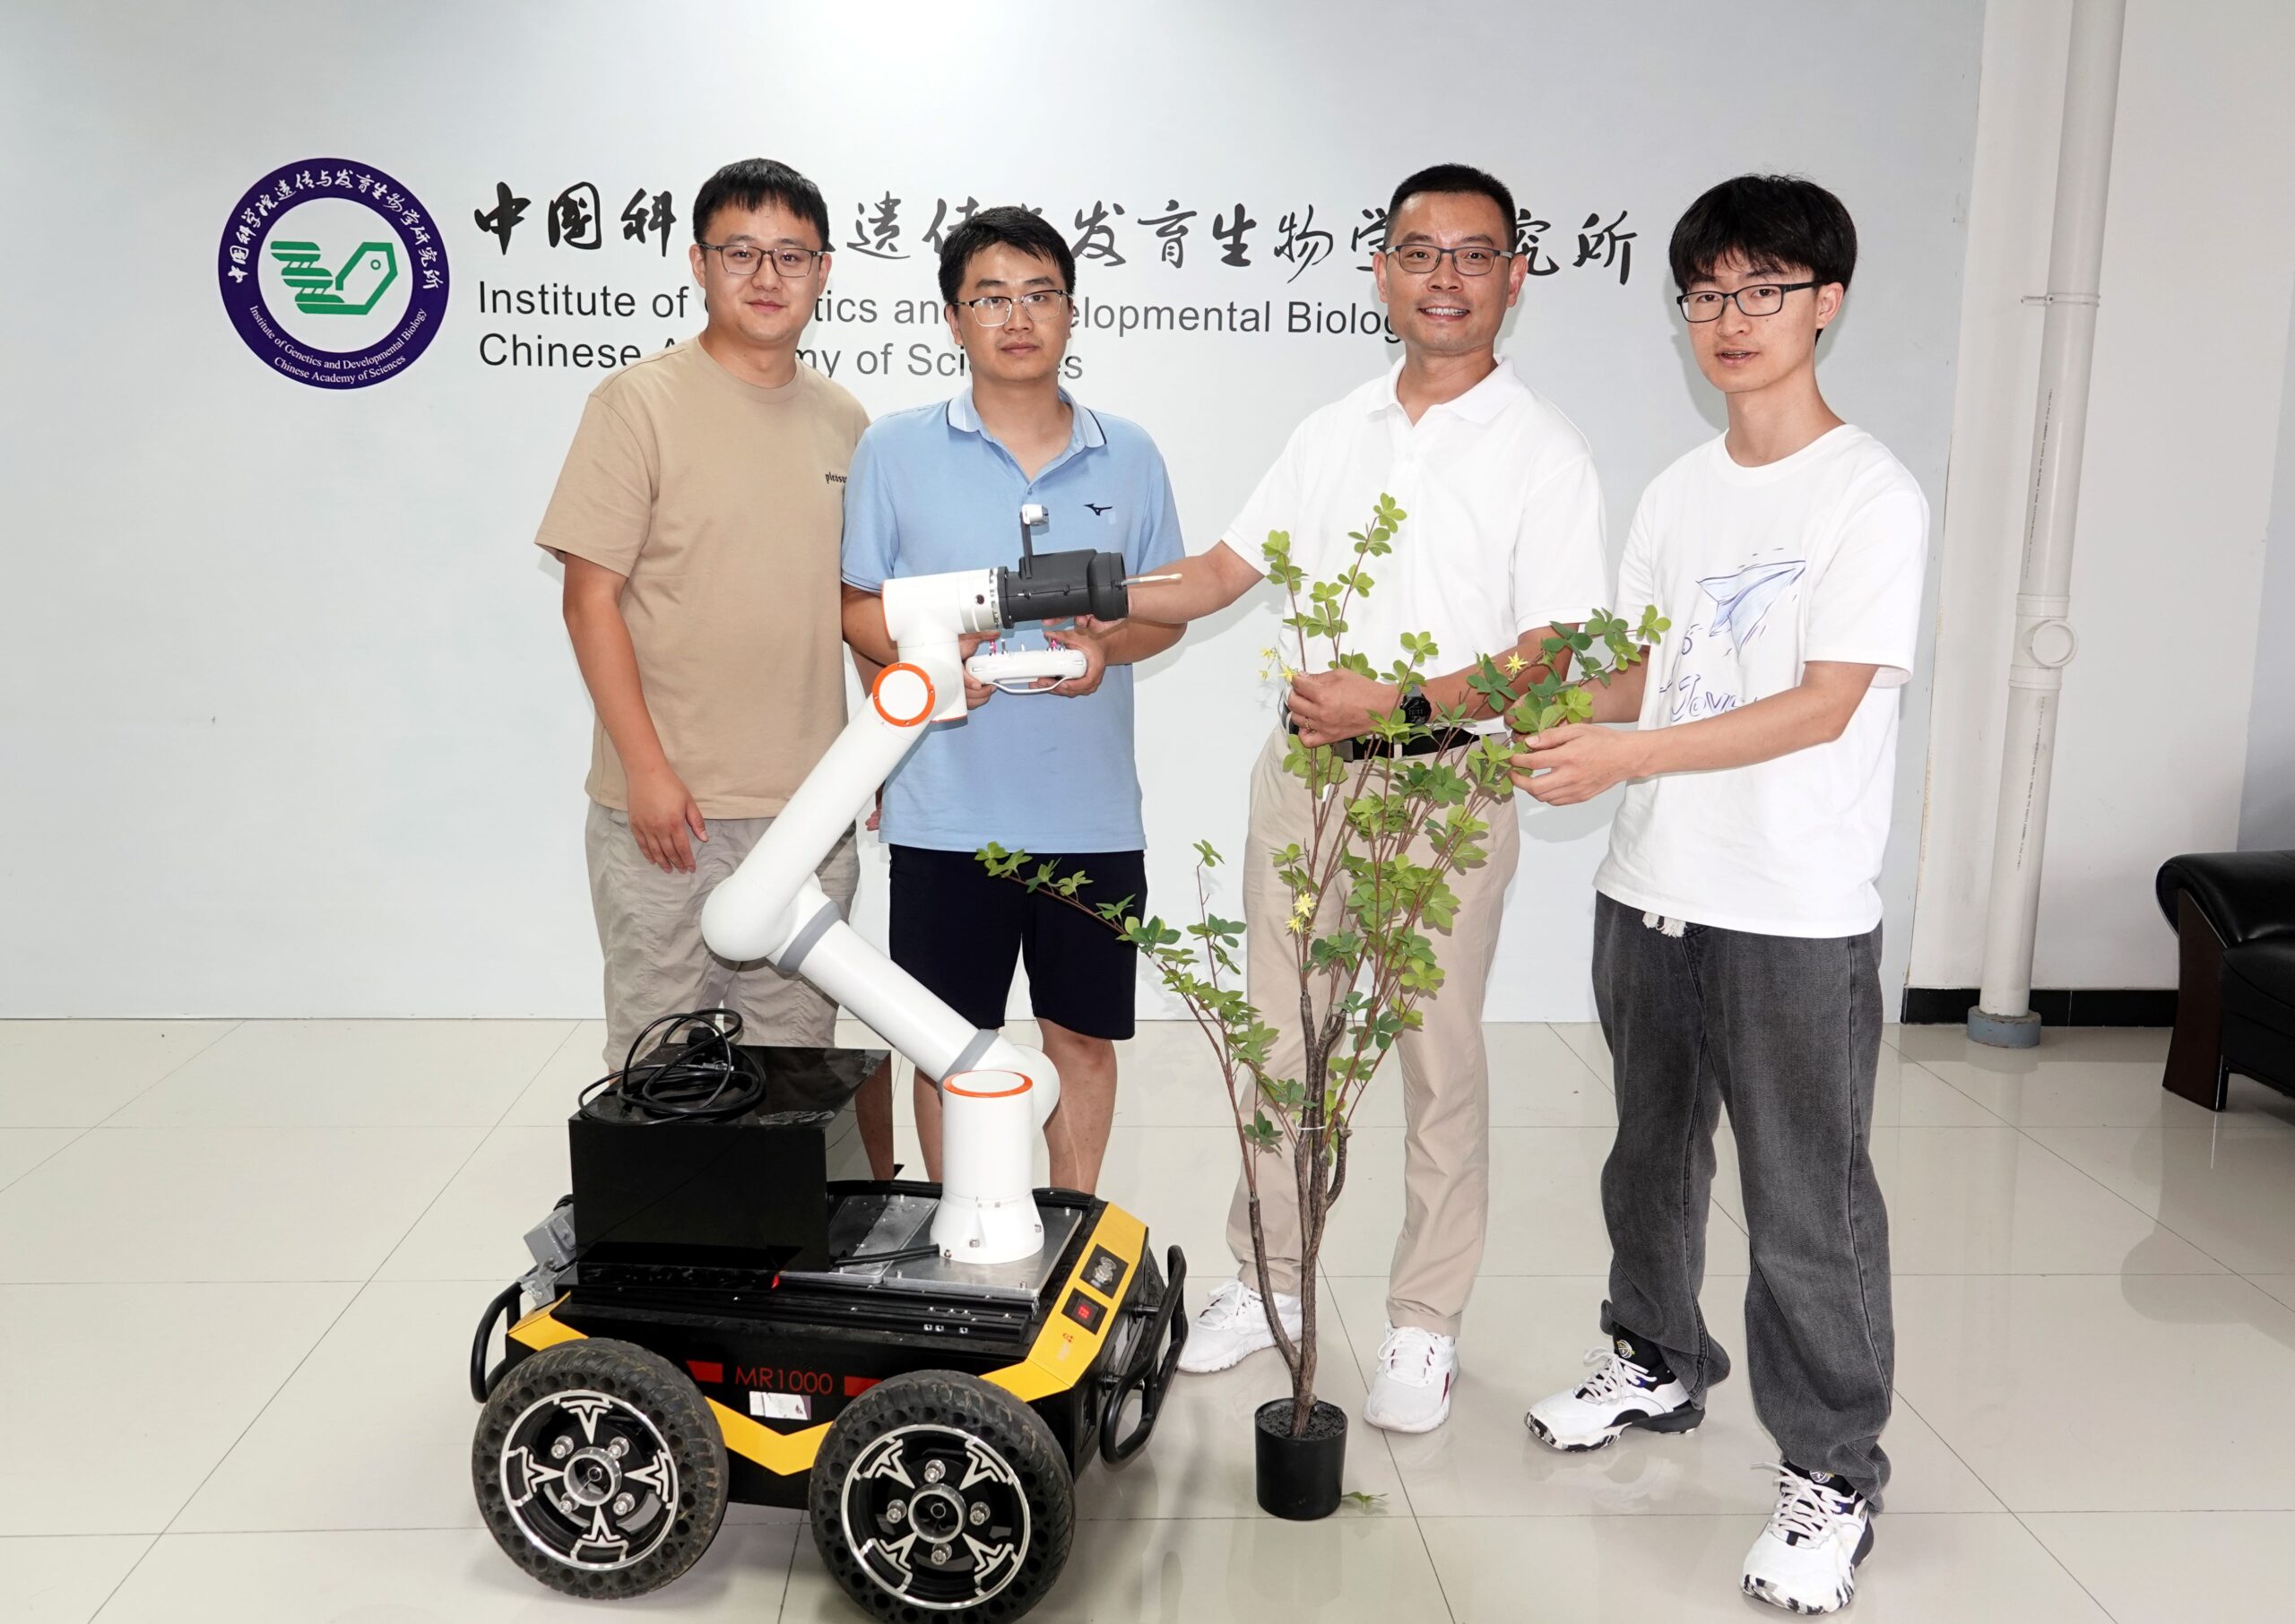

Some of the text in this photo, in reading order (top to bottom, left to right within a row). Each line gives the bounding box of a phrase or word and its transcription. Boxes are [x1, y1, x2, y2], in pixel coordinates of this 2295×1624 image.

[480, 281, 636, 316] Institute
[652, 286, 689, 318] of
[894, 299, 948, 324] an
[1070, 297, 1270, 338] lopmental
[1287, 301, 1401, 343] Biolog
[249, 305, 428, 370] Institute of Genetics and Developmental Biology
[480, 333, 641, 368] Chinese
[856, 342, 894, 375] of
[907, 343, 1083, 380] Scis
[274, 356, 406, 384] Chinese Academy of Sciences
[735, 1366, 833, 1395] MR1000
